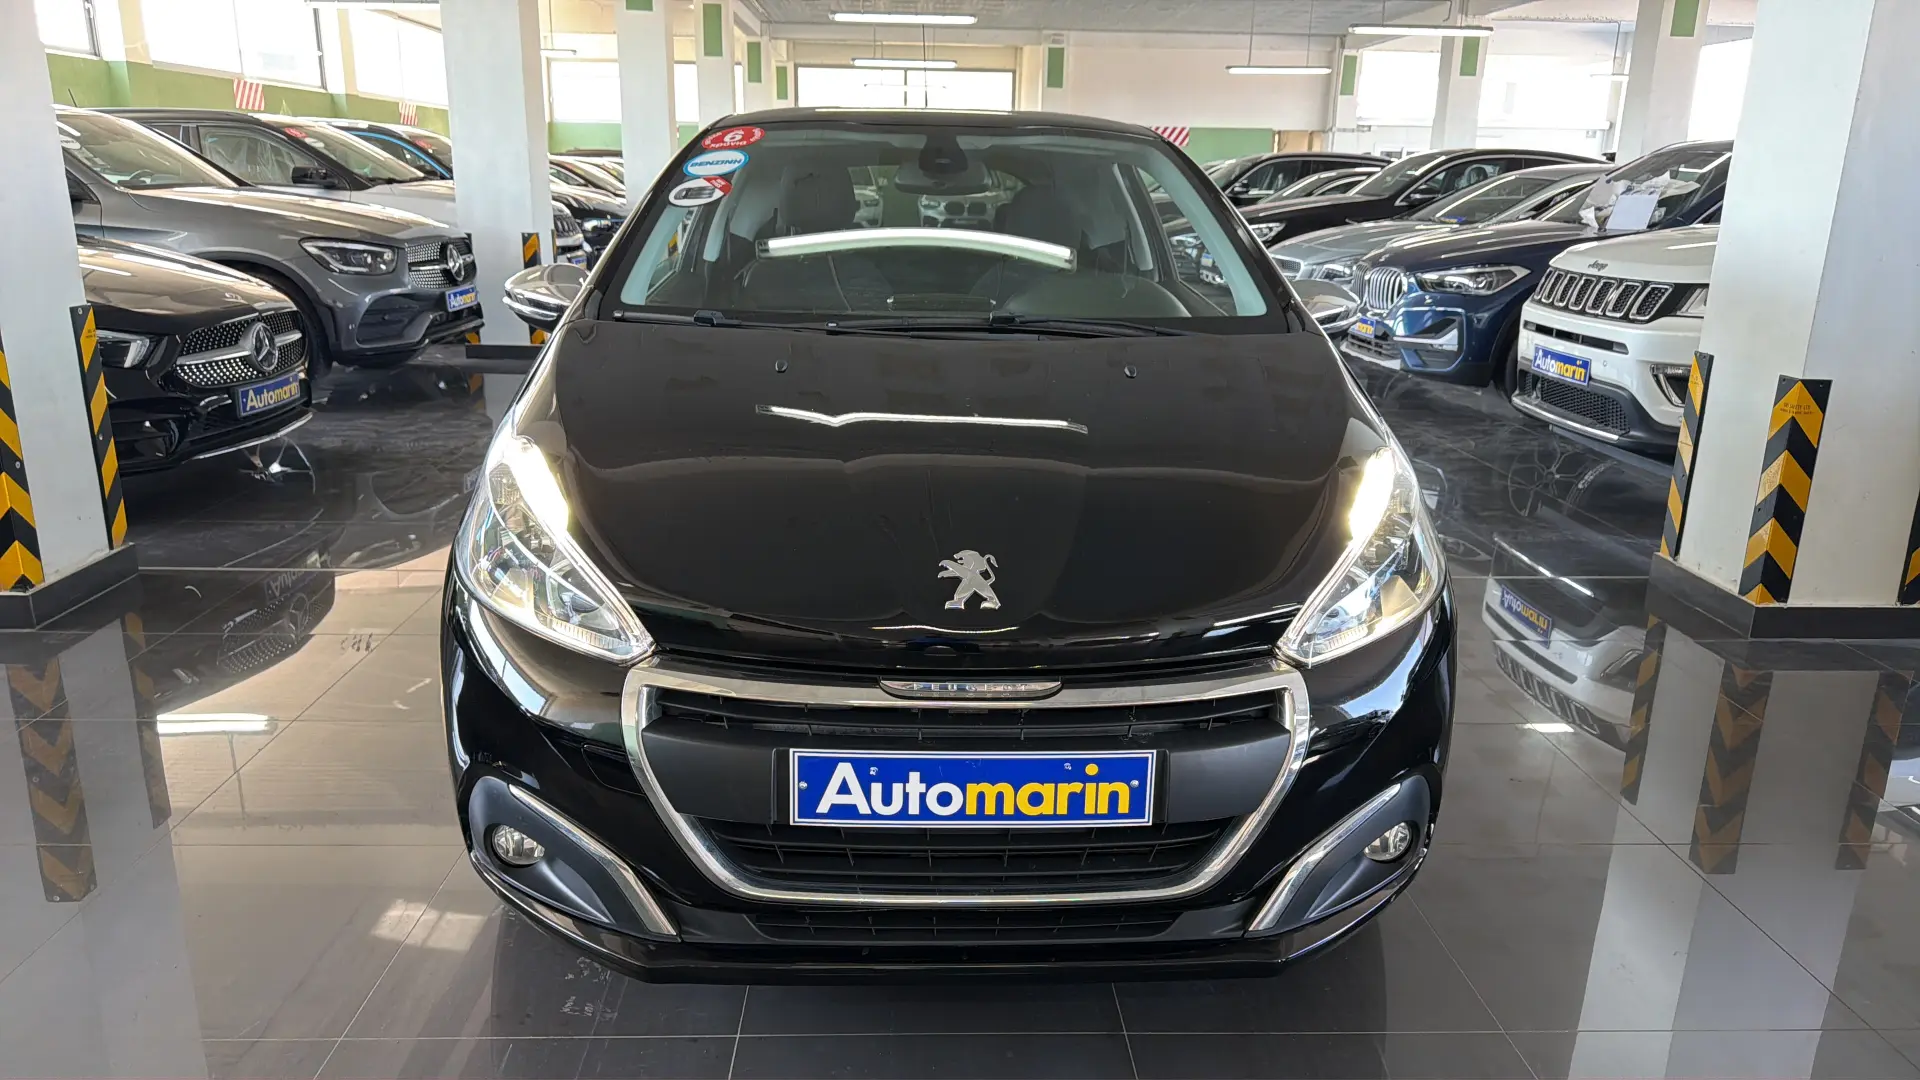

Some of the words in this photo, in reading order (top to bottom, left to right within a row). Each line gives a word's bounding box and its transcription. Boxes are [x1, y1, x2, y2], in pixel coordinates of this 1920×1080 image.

[723, 130, 745, 143] 6
[449, 289, 475, 307] Automarin
[1535, 348, 1586, 382] Automarin
[246, 377, 300, 411] Automarin
[913, 682, 1028, 692] PEUGEOT
[815, 761, 1131, 816] Automarin
